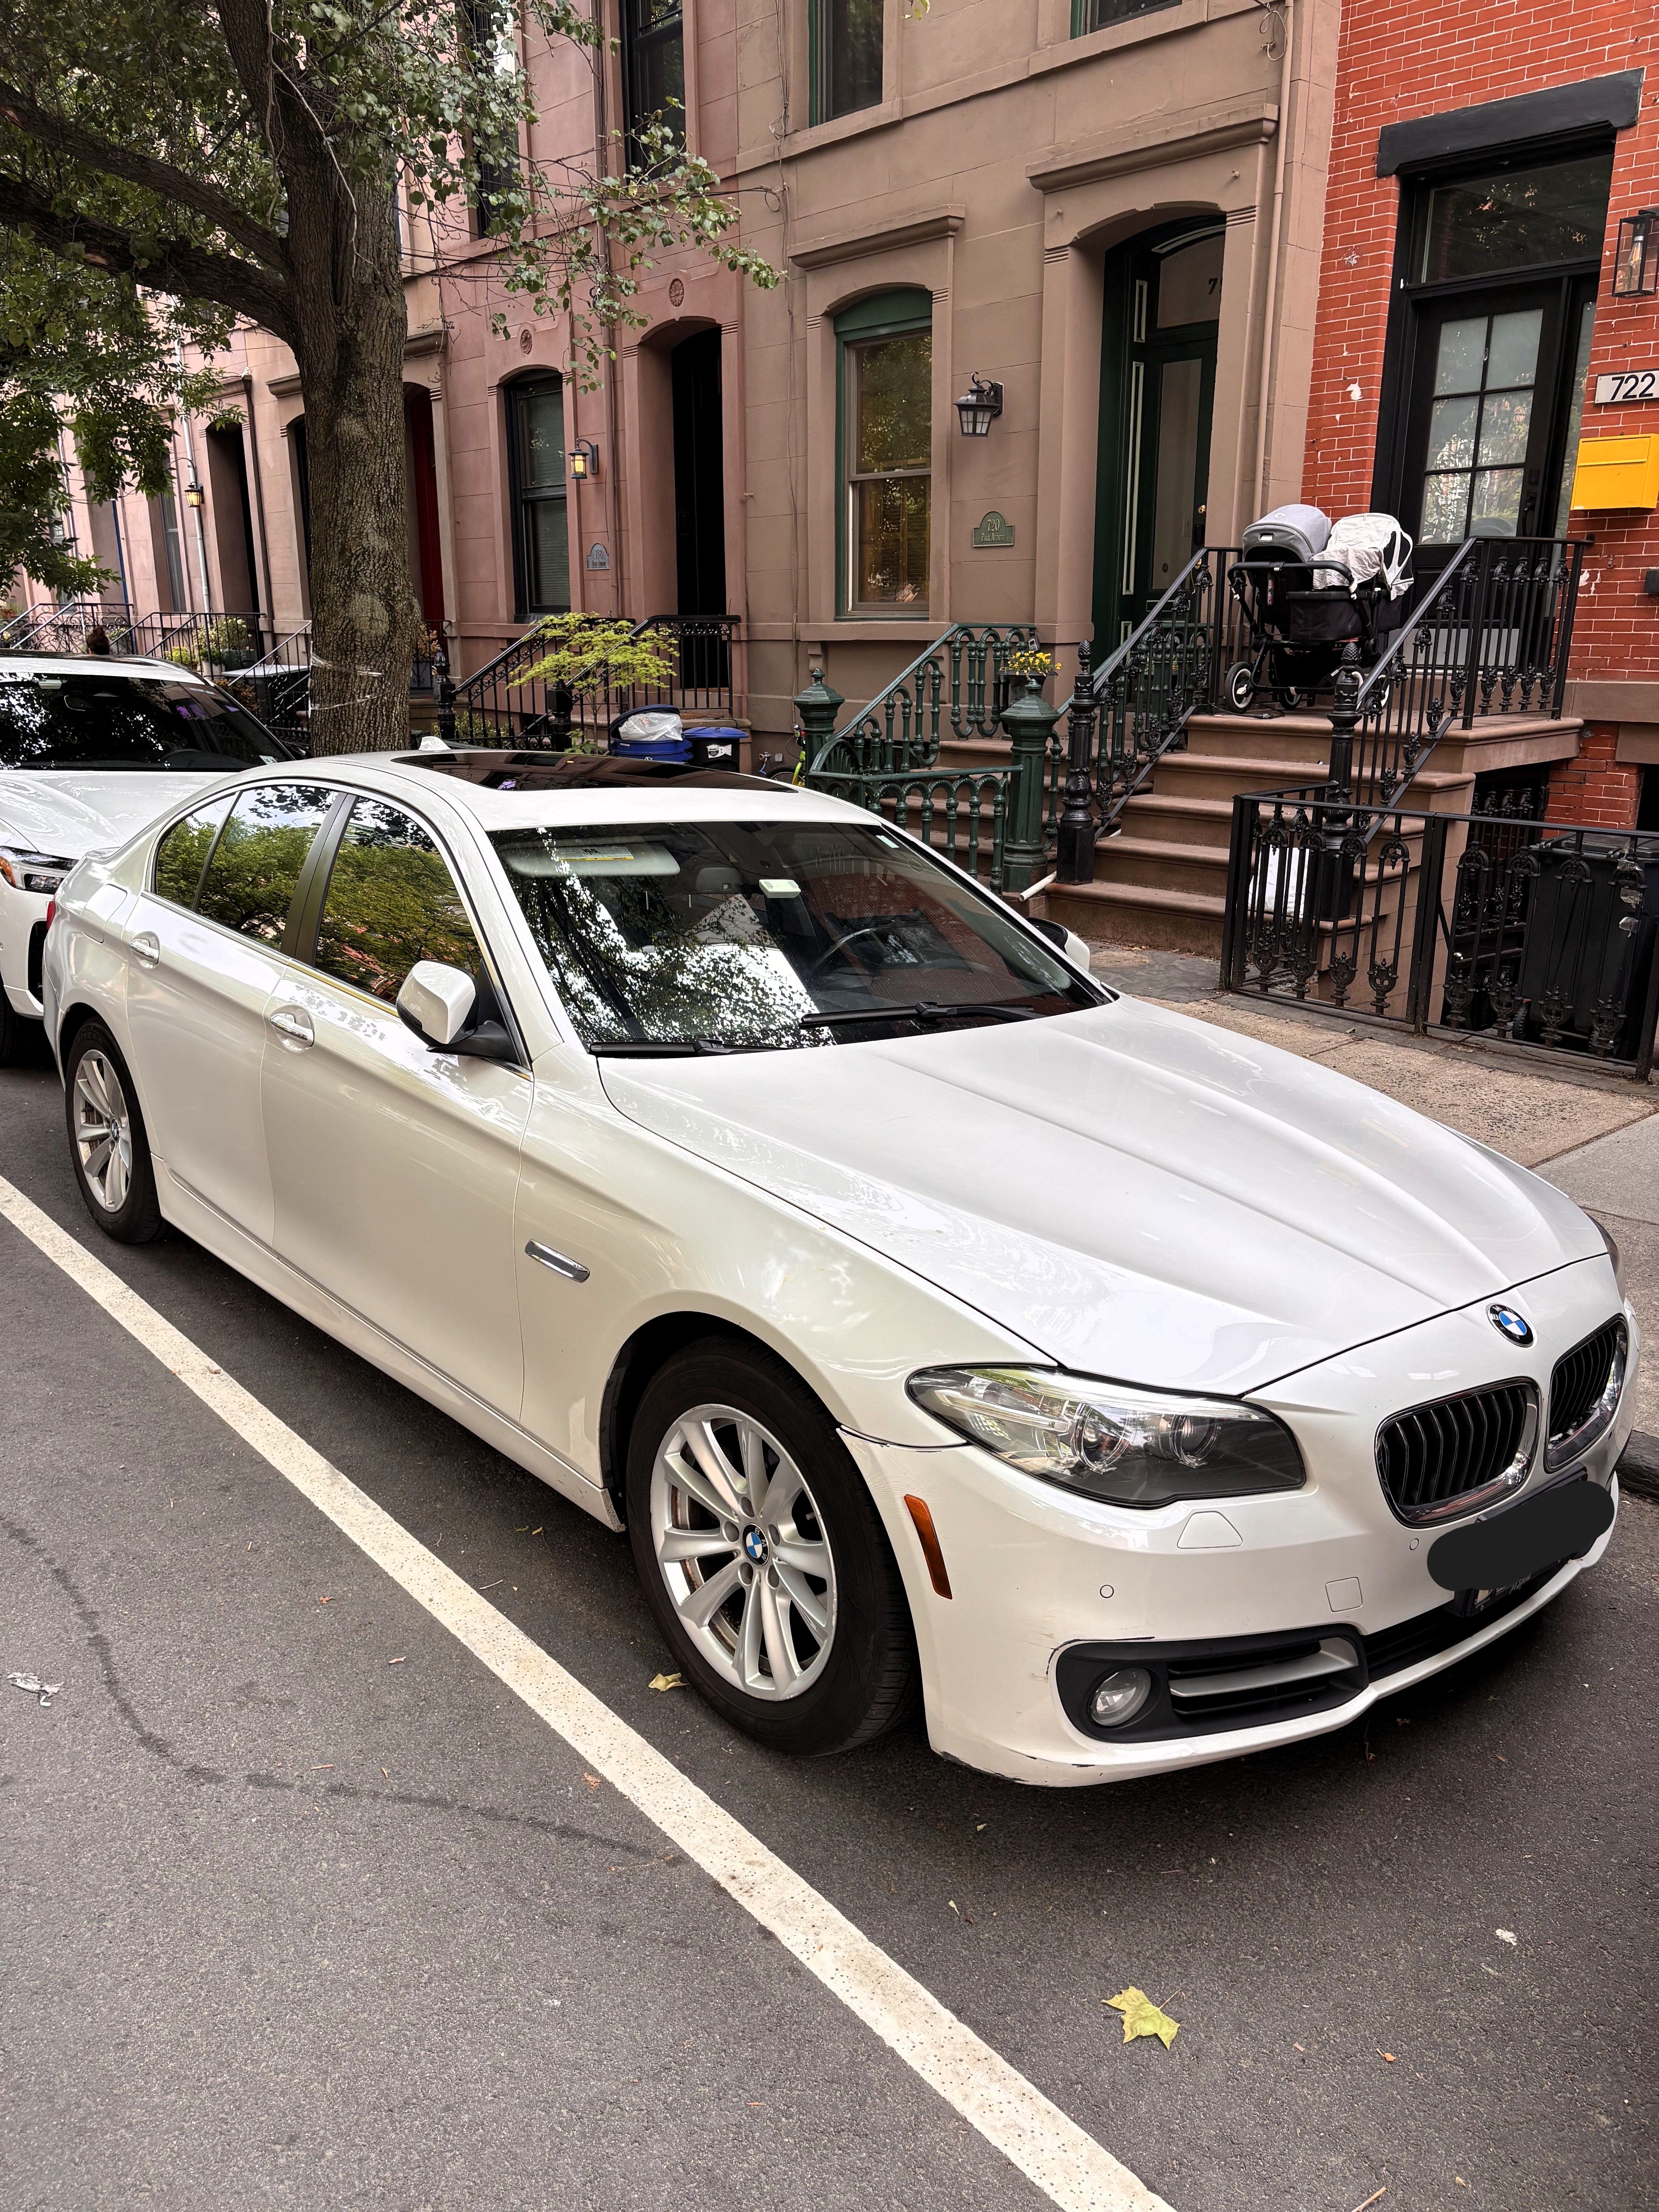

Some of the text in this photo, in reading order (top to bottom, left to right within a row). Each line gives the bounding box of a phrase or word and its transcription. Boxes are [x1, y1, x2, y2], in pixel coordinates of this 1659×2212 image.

[1208, 278, 1223, 295] 7
[1610, 373, 1656, 400] 722
[988, 519, 1000, 532] 720
[754, 1527, 767, 1561] BMW
